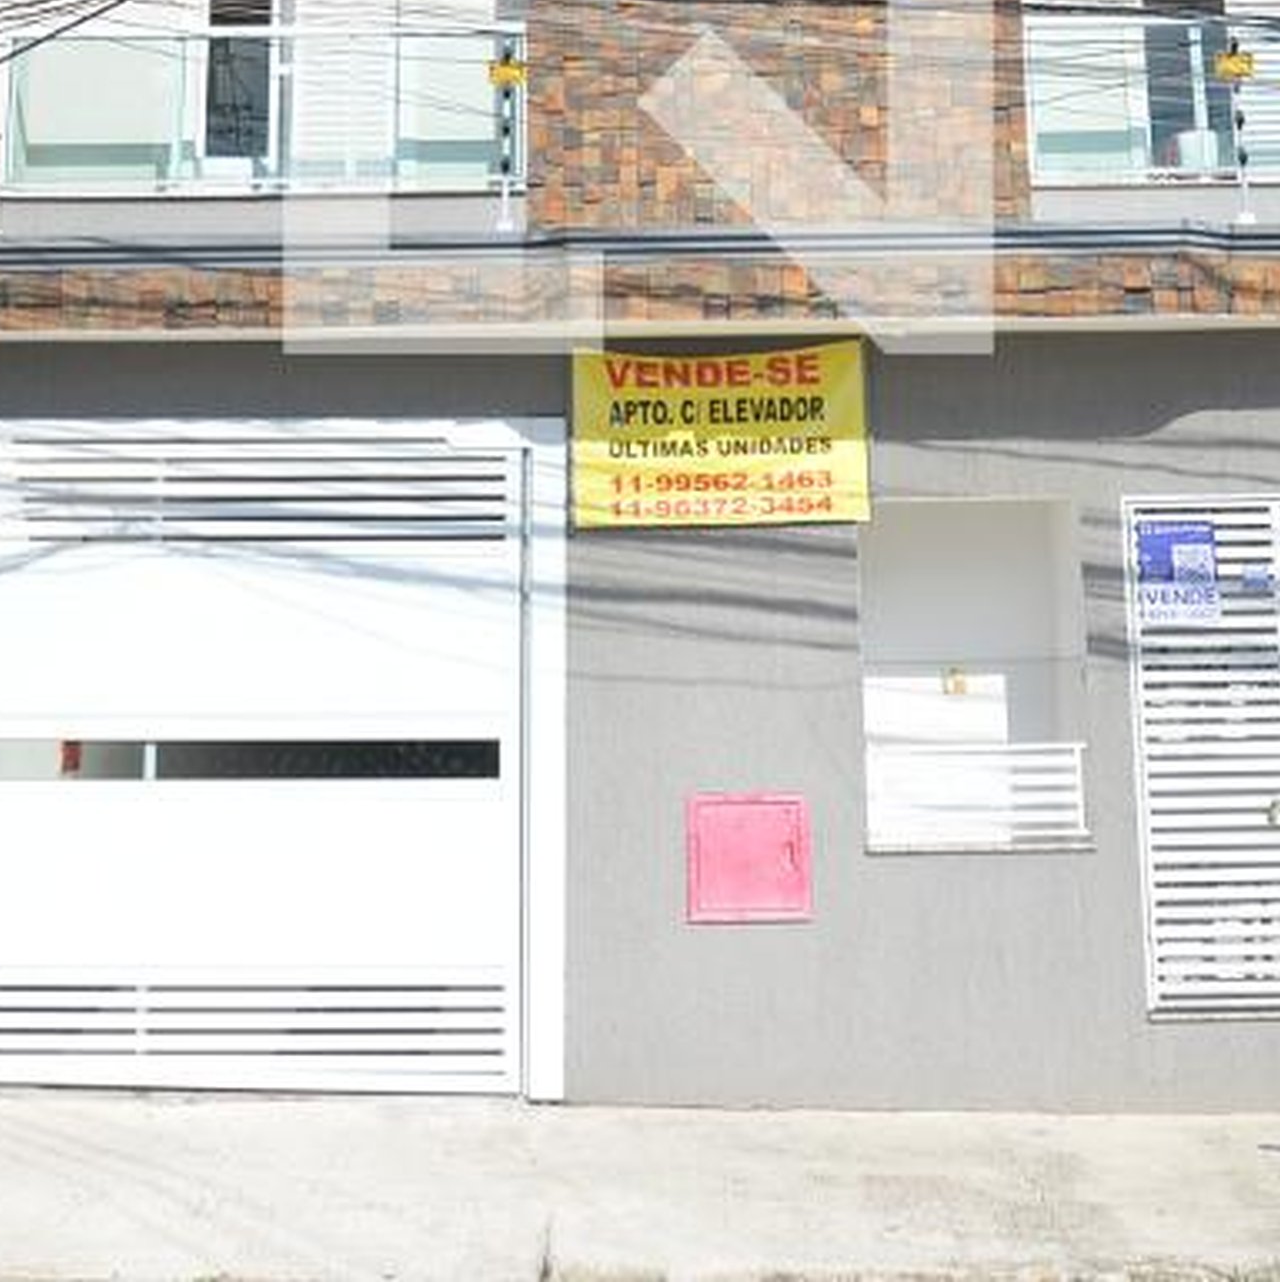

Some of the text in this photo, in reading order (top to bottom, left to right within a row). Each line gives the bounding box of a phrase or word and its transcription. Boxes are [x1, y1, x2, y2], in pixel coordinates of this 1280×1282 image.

[603, 354, 821, 390] VENDE-SE
[708, 396, 826, 424] ELEVADOR
[716, 435, 832, 457] UNIDADES
